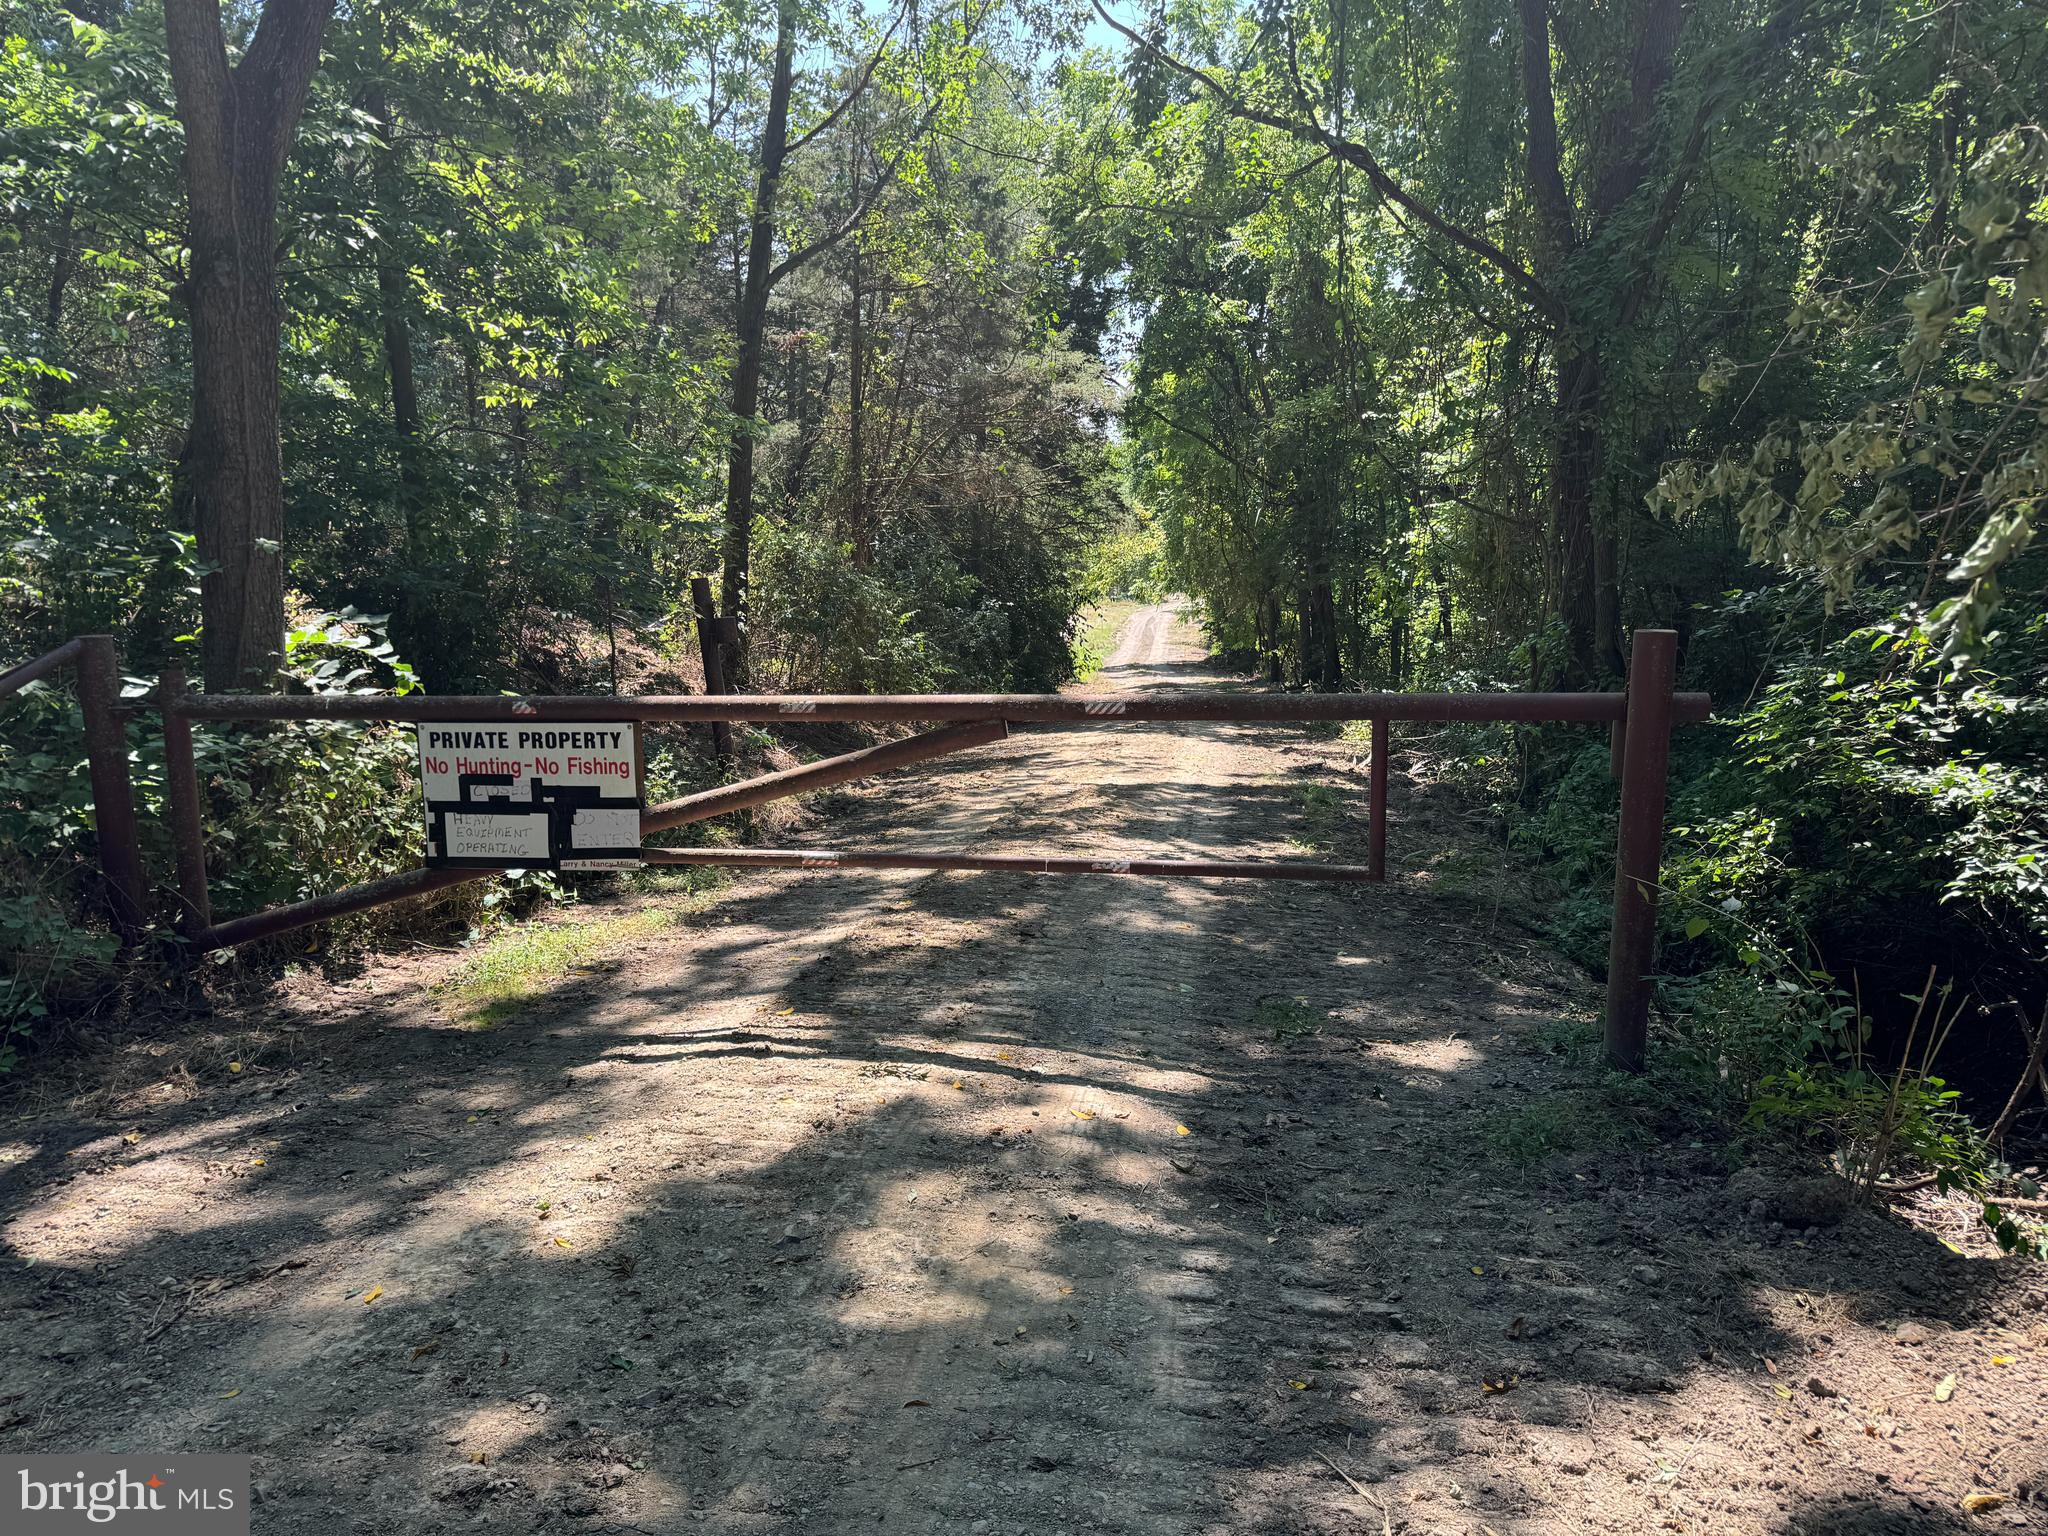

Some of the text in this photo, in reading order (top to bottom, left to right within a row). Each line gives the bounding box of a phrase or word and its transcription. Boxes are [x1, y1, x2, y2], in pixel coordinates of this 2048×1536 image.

[429, 732, 621, 749] PRIVATE PROPERTY
[425, 756, 448, 774] No
[567, 757, 630, 779] Fishing
[453, 813, 494, 827] HEAVY
[456, 826, 533, 839] EQUIPMENT
[456, 842, 529, 857] OPERATING
